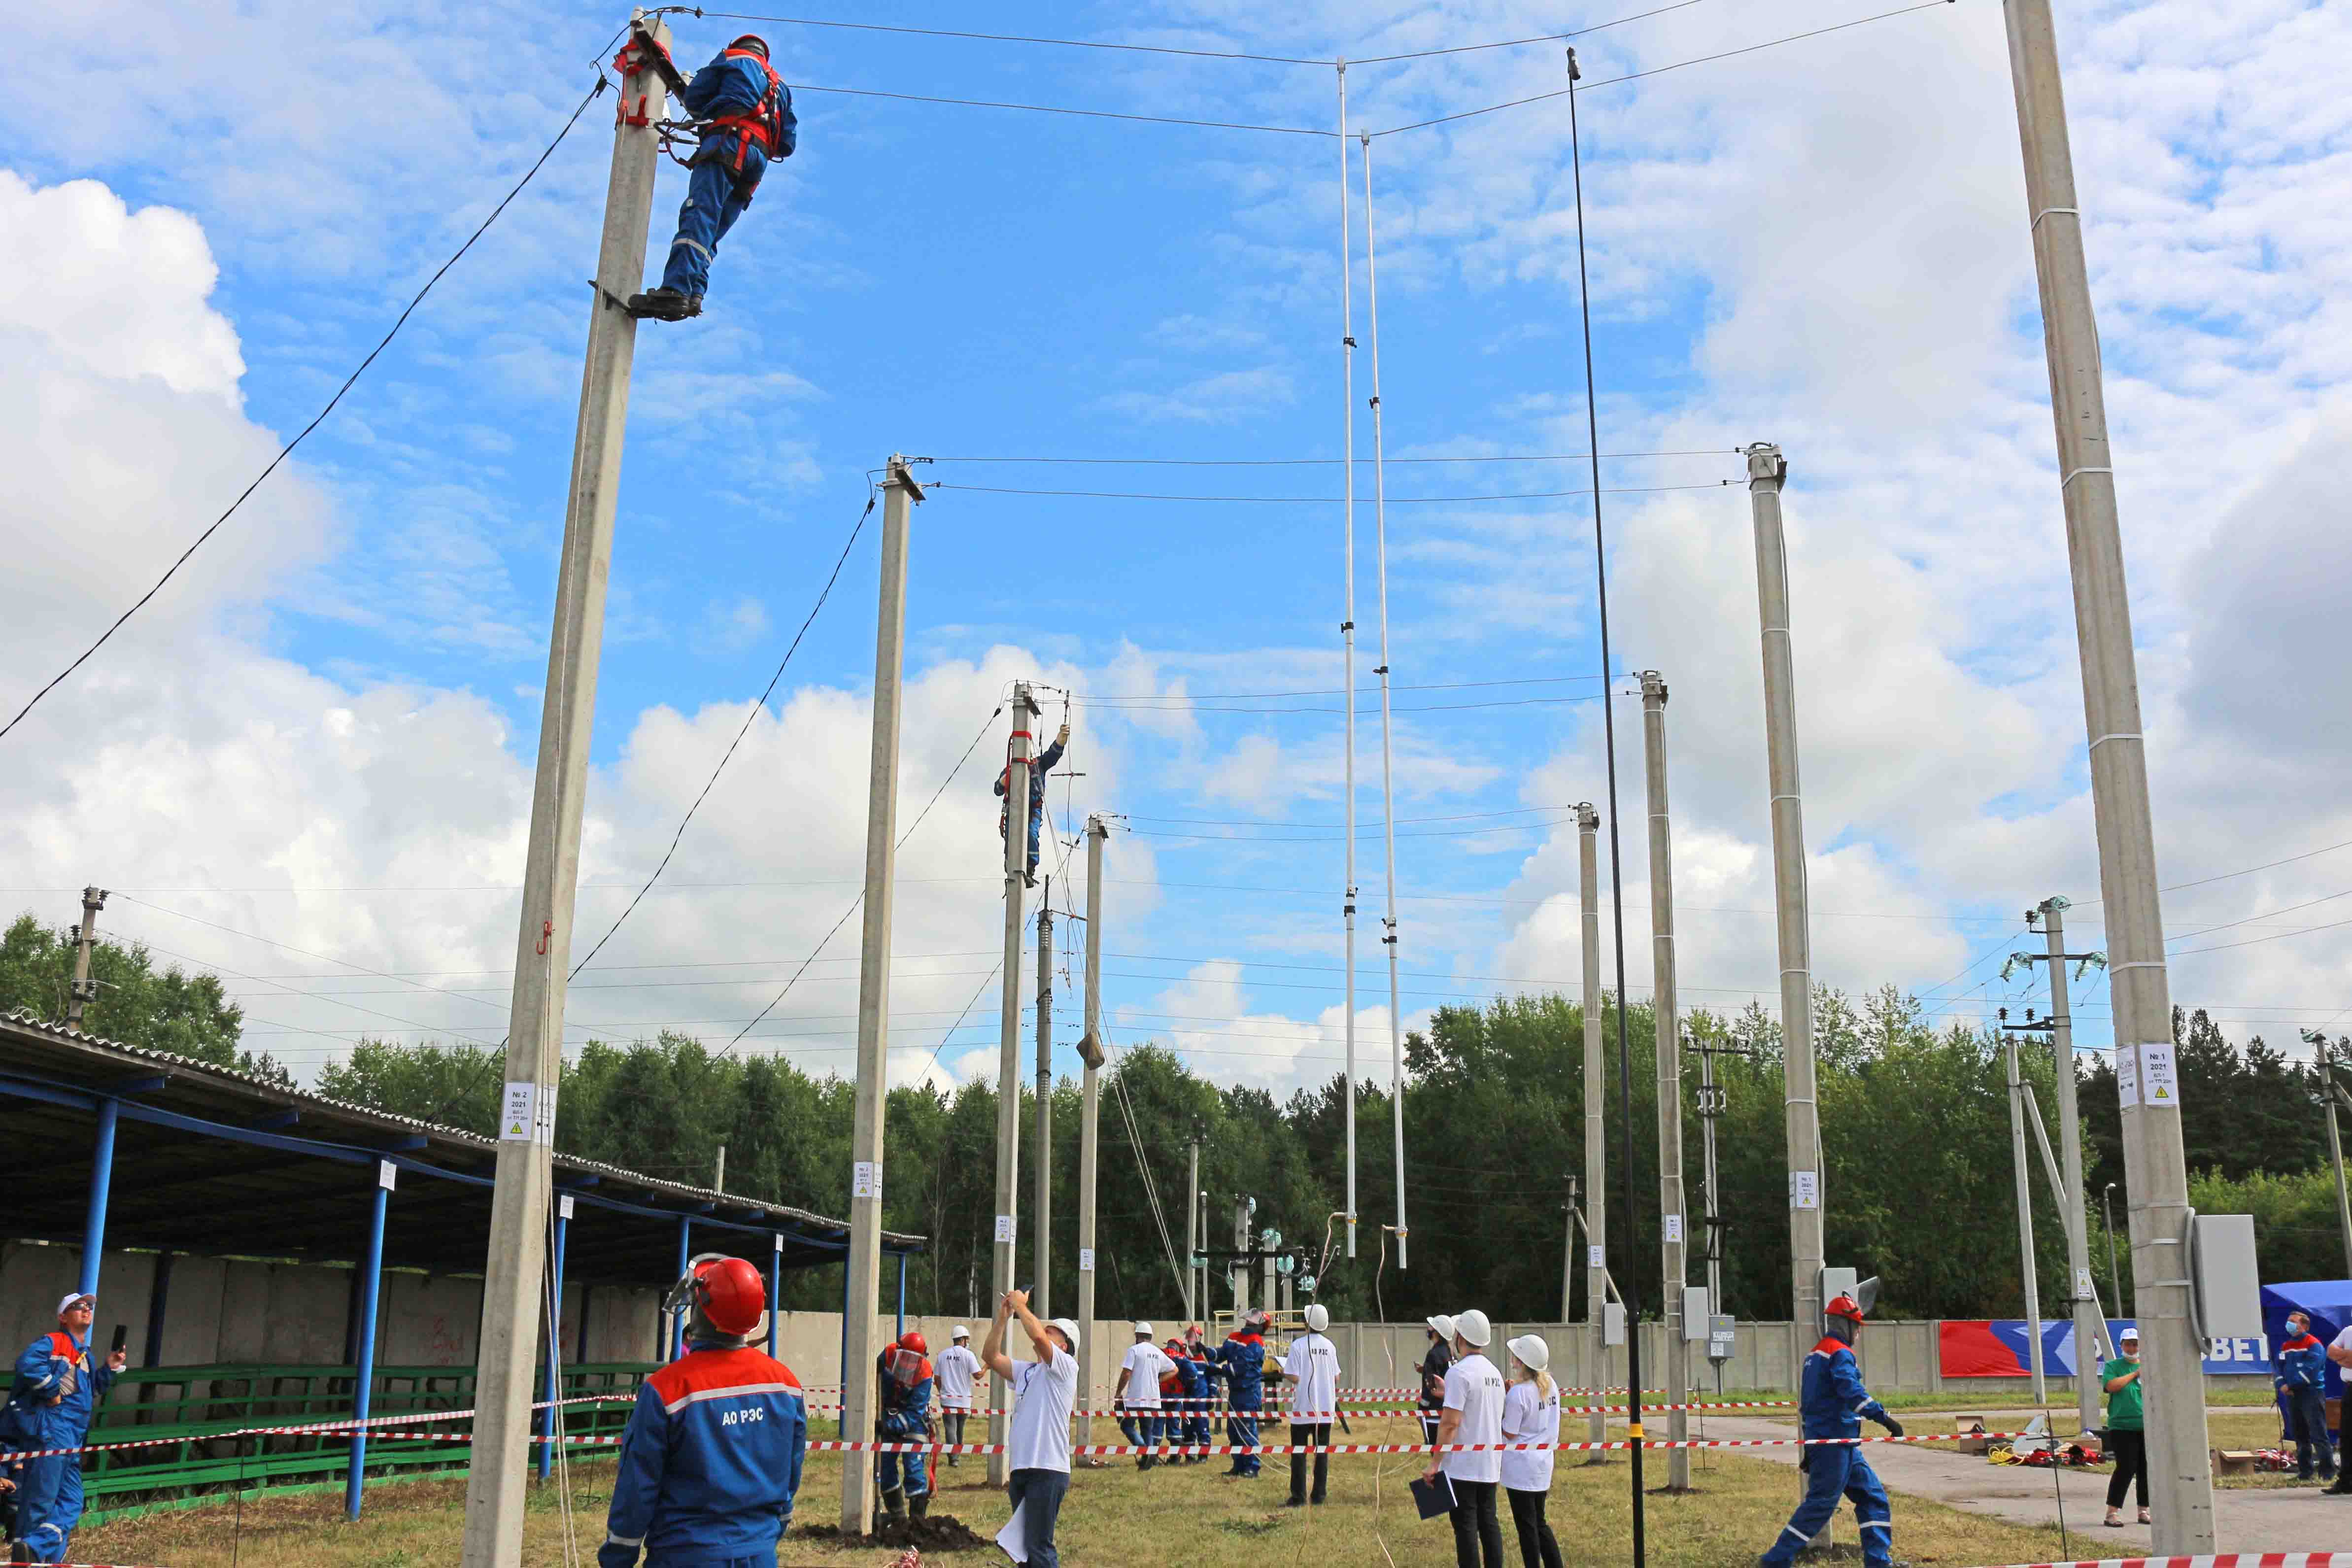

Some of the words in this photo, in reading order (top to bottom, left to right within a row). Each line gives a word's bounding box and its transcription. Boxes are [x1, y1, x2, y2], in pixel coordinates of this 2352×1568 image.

[2200, 1332, 2269, 1361] ВЕТ
[722, 1411, 737, 1426] АО
[740, 1407, 763, 1423] РЭС
